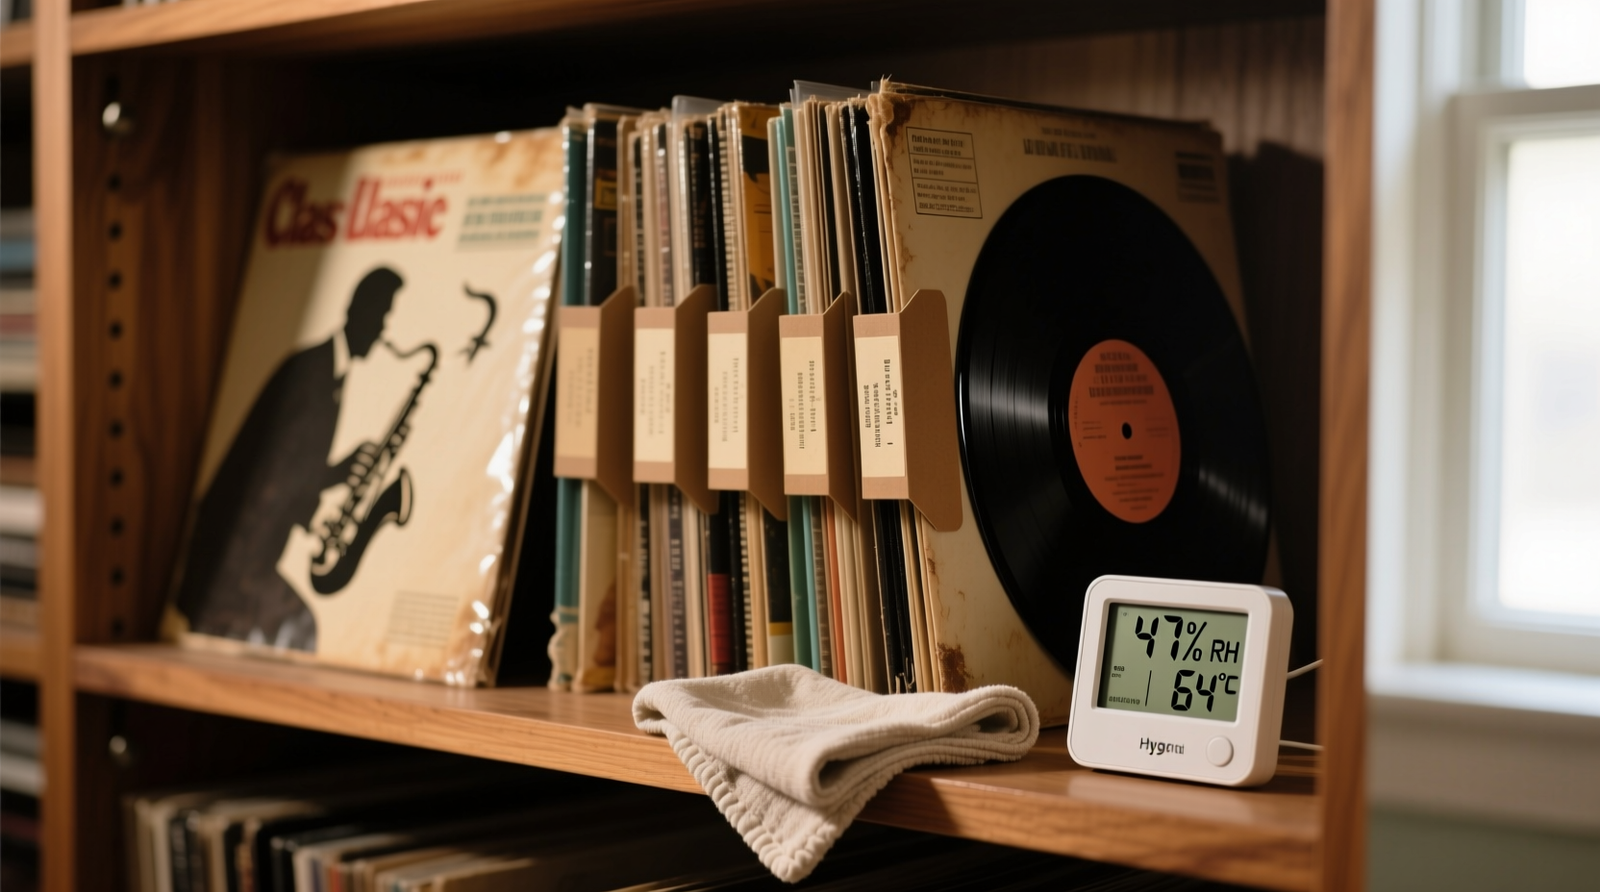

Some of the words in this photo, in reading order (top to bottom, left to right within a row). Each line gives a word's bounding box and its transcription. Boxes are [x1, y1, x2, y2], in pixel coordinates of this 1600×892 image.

[1134, 615, 1208, 662] 47%
[1209, 639, 1240, 664] RH
[1170, 669, 1239, 712] 64°C
